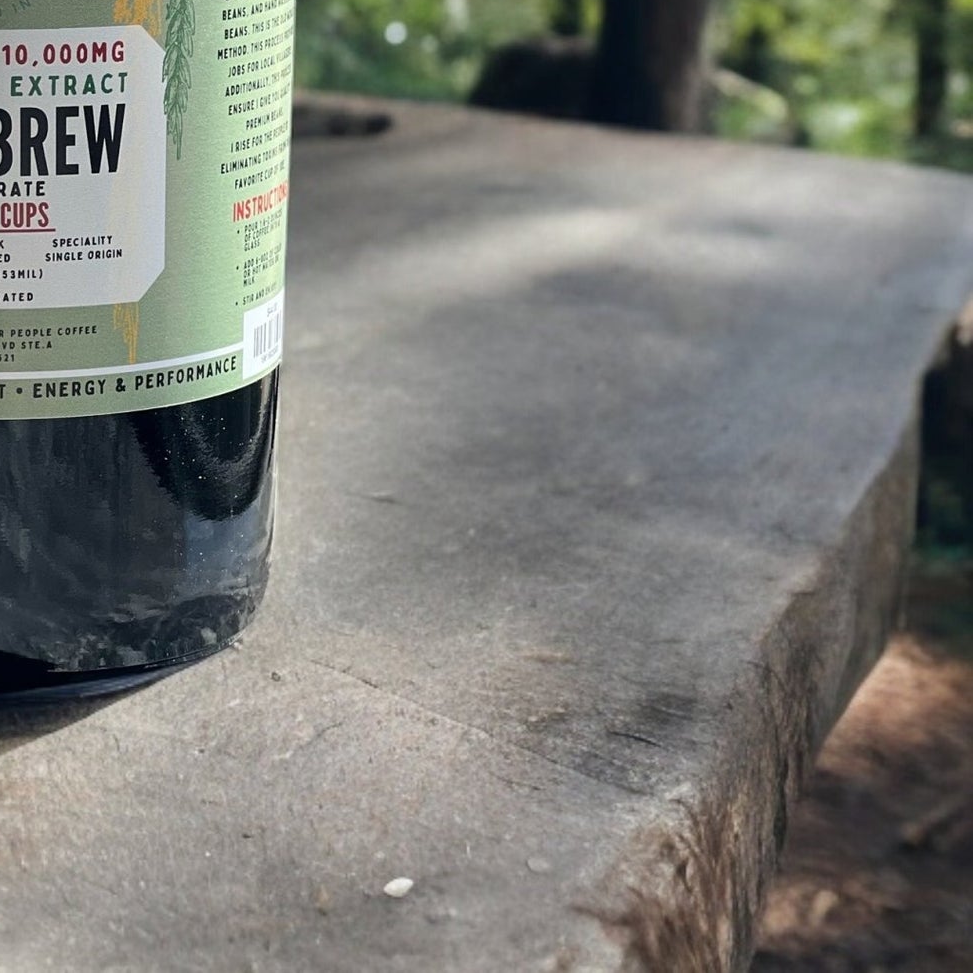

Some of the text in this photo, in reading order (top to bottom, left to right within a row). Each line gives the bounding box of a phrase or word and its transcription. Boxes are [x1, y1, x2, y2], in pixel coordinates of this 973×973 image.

[251, 2, 264, 15] AND
[252, 21, 264, 34] THIS
[2, 40, 125, 67] 10,000MG
[251, 40, 264, 53] THIS
[228, 64, 245, 78] JOBS
[247, 60, 260, 73] FOR
[10, 72, 128, 97] EXTRACT
[228, 99, 255, 115] ENSURE
[235, 138, 250, 153] RISE
[252, 134, 263, 147] FOR
[220, 154, 262, 174] ELIMINATING
[235, 171, 264, 189] FAVORITE
[0, 202, 49, 228] CUPS
[52, 235, 113, 248] SPECIALITY
[45, 248, 123, 262] SINGLE ORIGIN
[242, 293, 255, 306] STIR
[10, 327, 52, 338] PEOPLE
[57, 325, 98, 337] COFFEE
[21, 338, 53, 350] STE.A
[32, 378, 106, 400] ENERGY
[115, 377, 126, 393] &
[134, 355, 237, 392] PERFORMANCE
